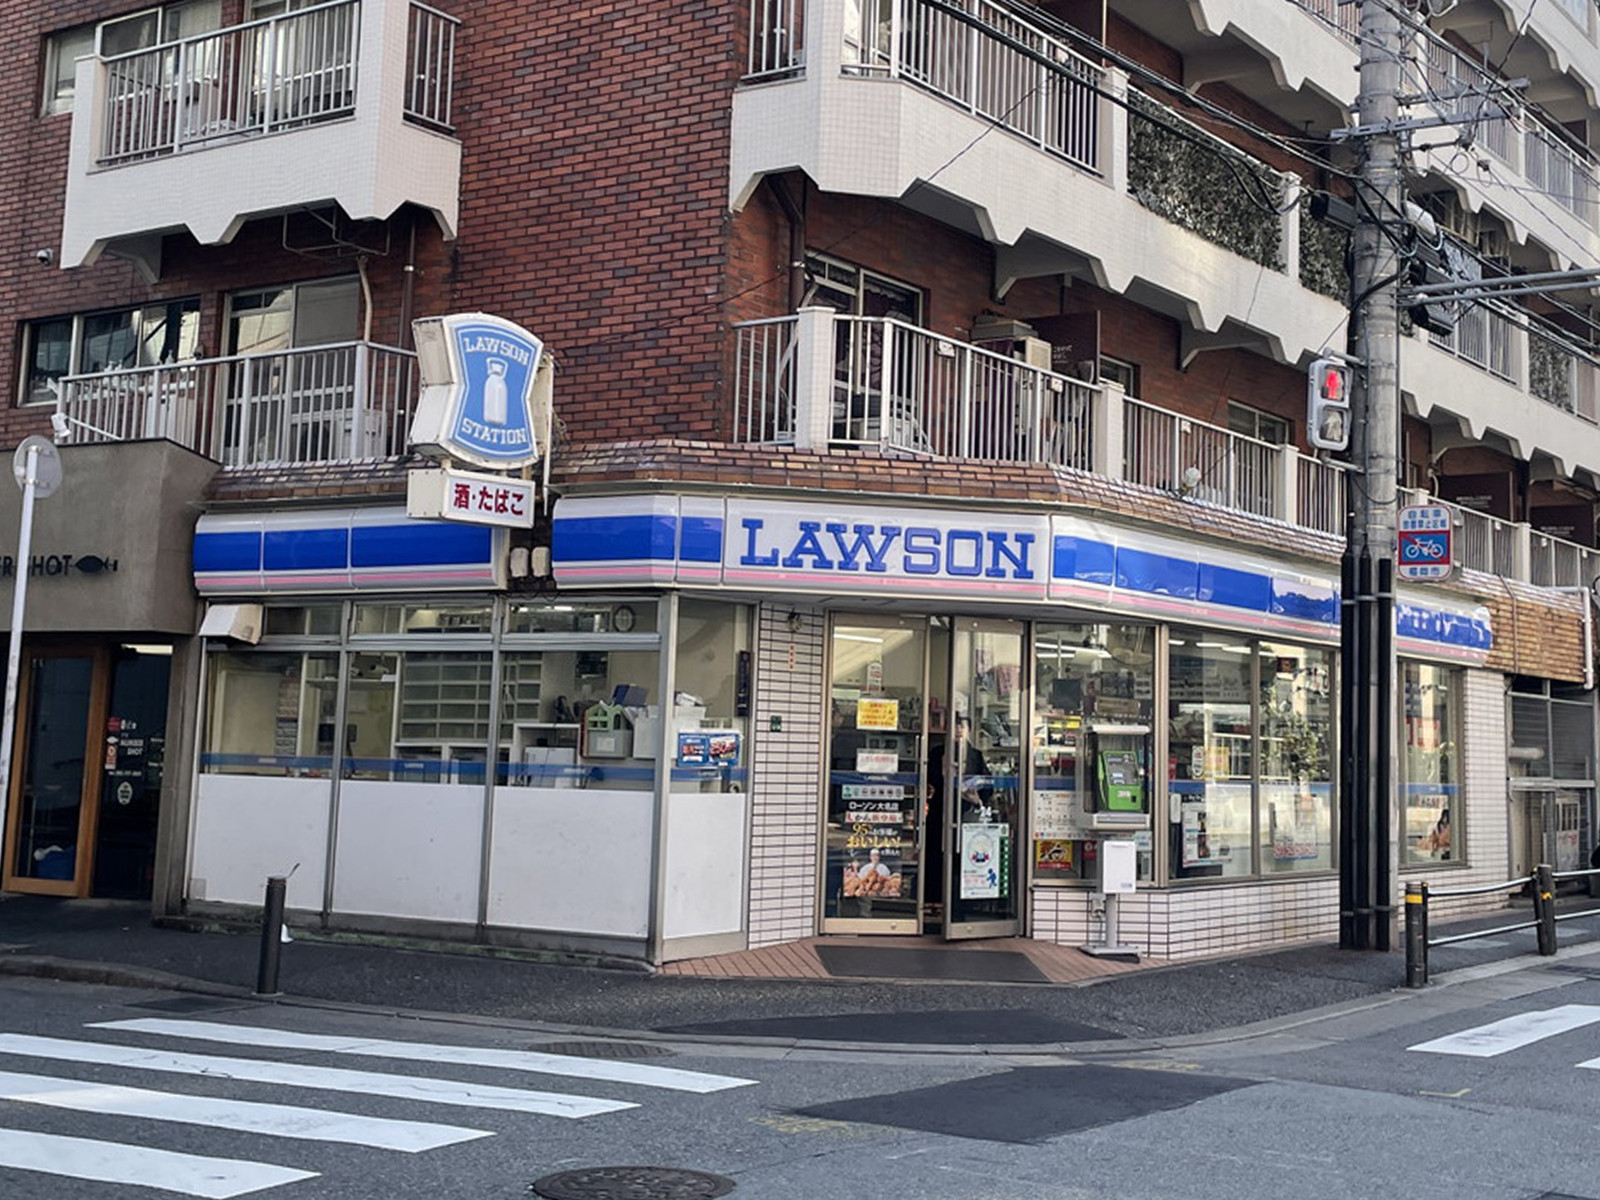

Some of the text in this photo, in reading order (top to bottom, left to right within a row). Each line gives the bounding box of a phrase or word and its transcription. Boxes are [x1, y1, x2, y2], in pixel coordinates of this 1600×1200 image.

[463, 337, 530, 365] LAWSON
[461, 418, 527, 445] STATION
[453, 483, 524, 515] 酒・たばこ
[740, 518, 1035, 579] LAWSON
[0, 555, 72, 577] R HOT
